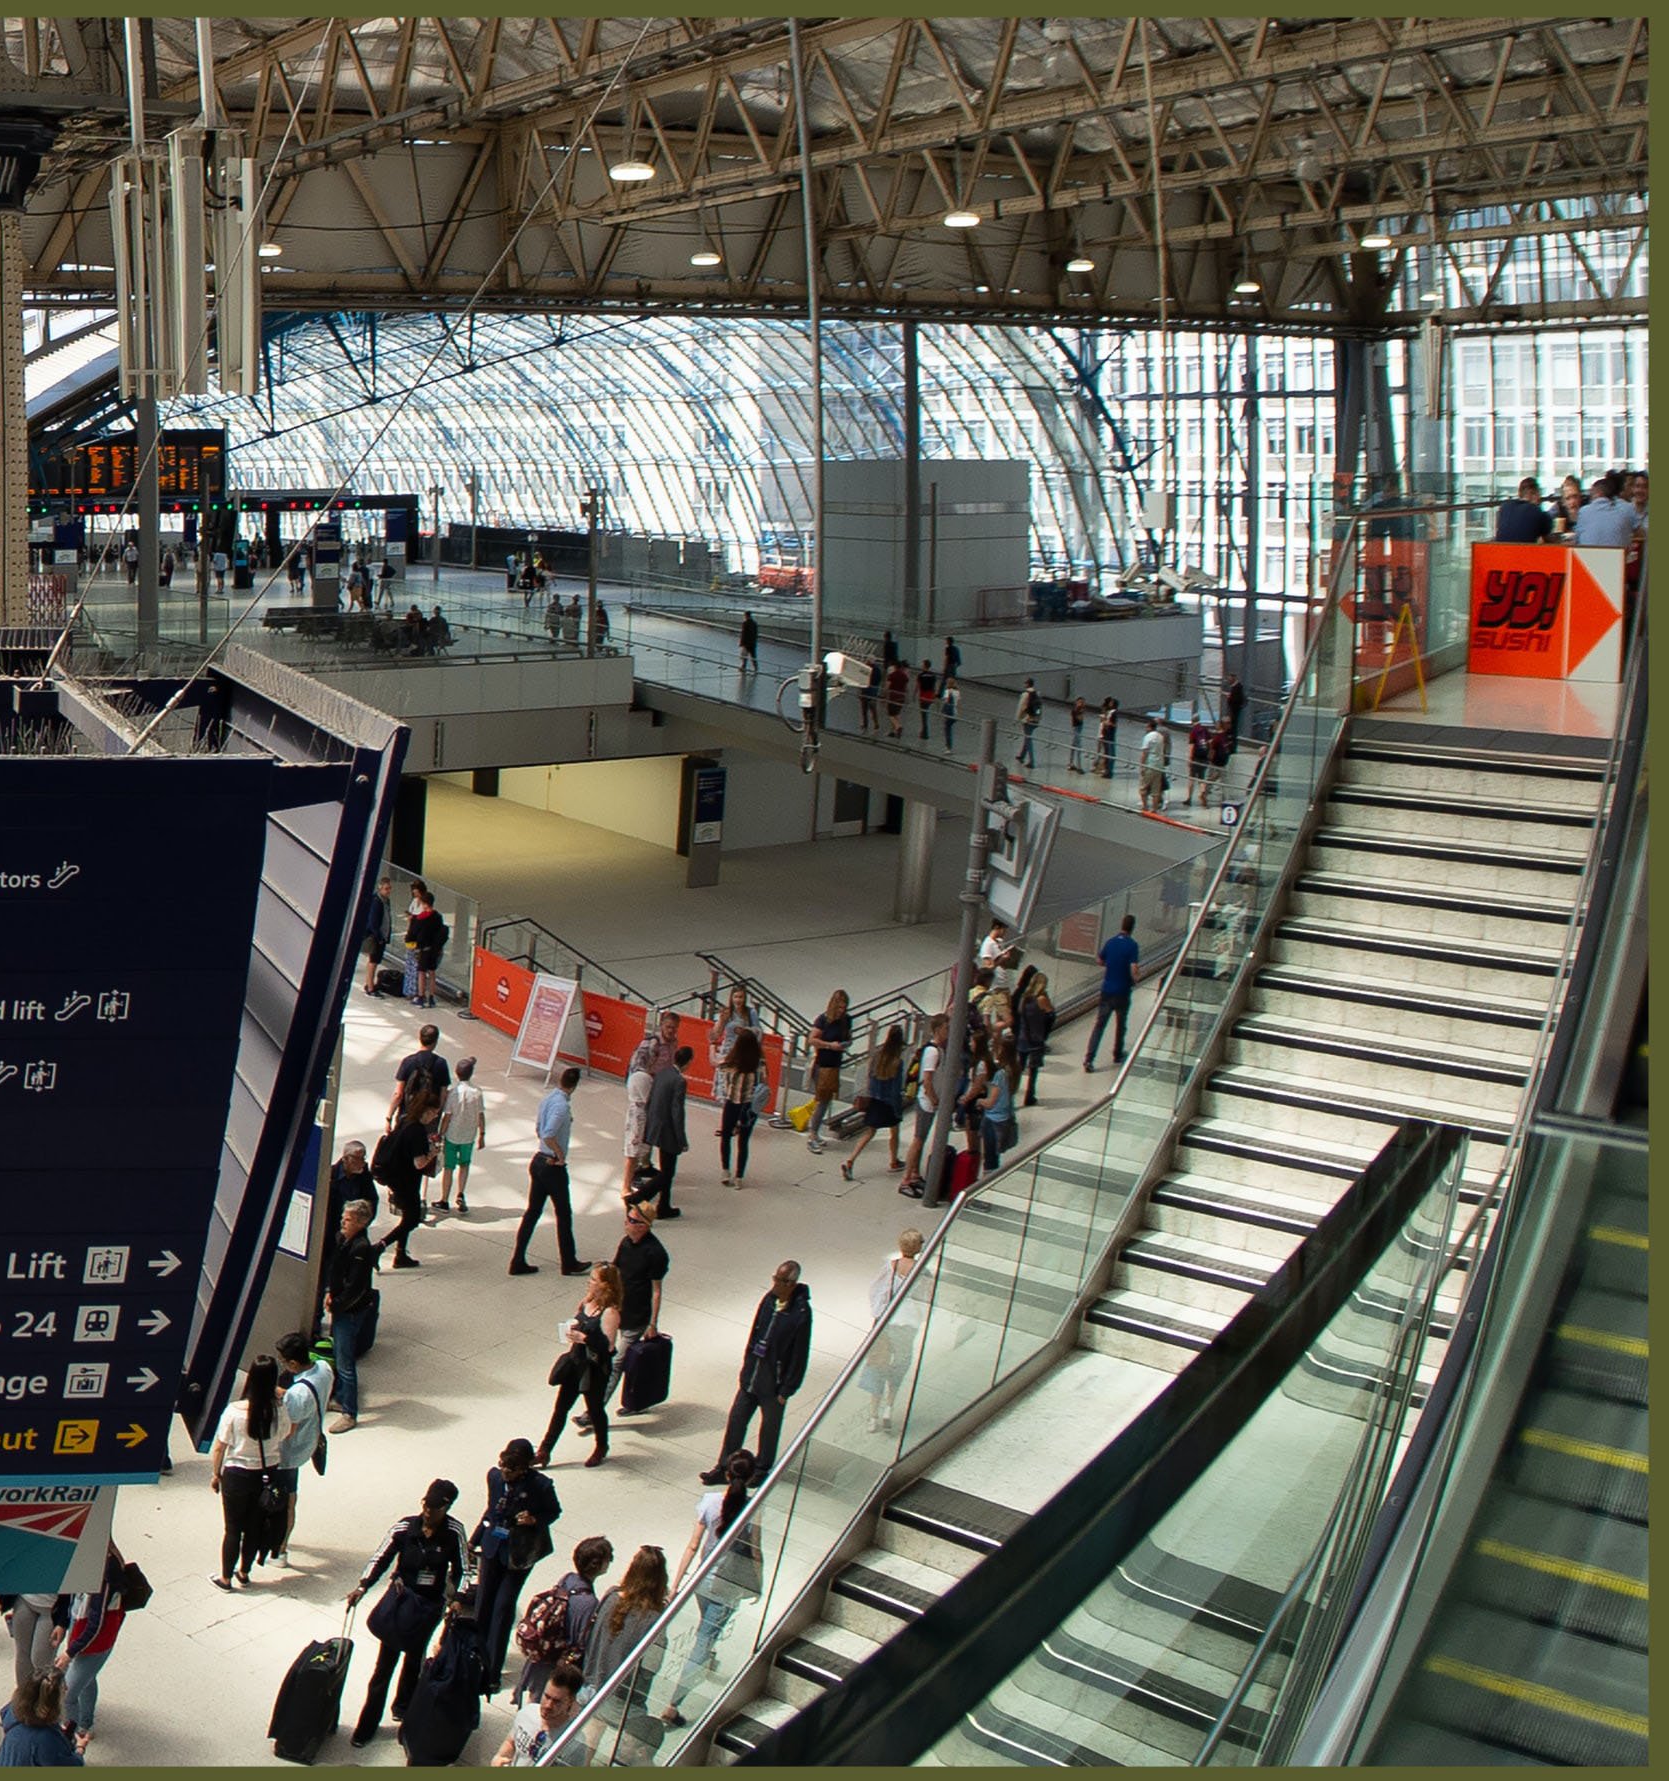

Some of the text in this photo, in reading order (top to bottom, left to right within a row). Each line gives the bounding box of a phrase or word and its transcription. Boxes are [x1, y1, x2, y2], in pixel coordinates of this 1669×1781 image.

[1477, 570, 1566, 631] YO!
[13, 1001, 44, 1020] lift
[8, 1252, 67, 1279] Lift
[12, 1311, 56, 1338] 24
